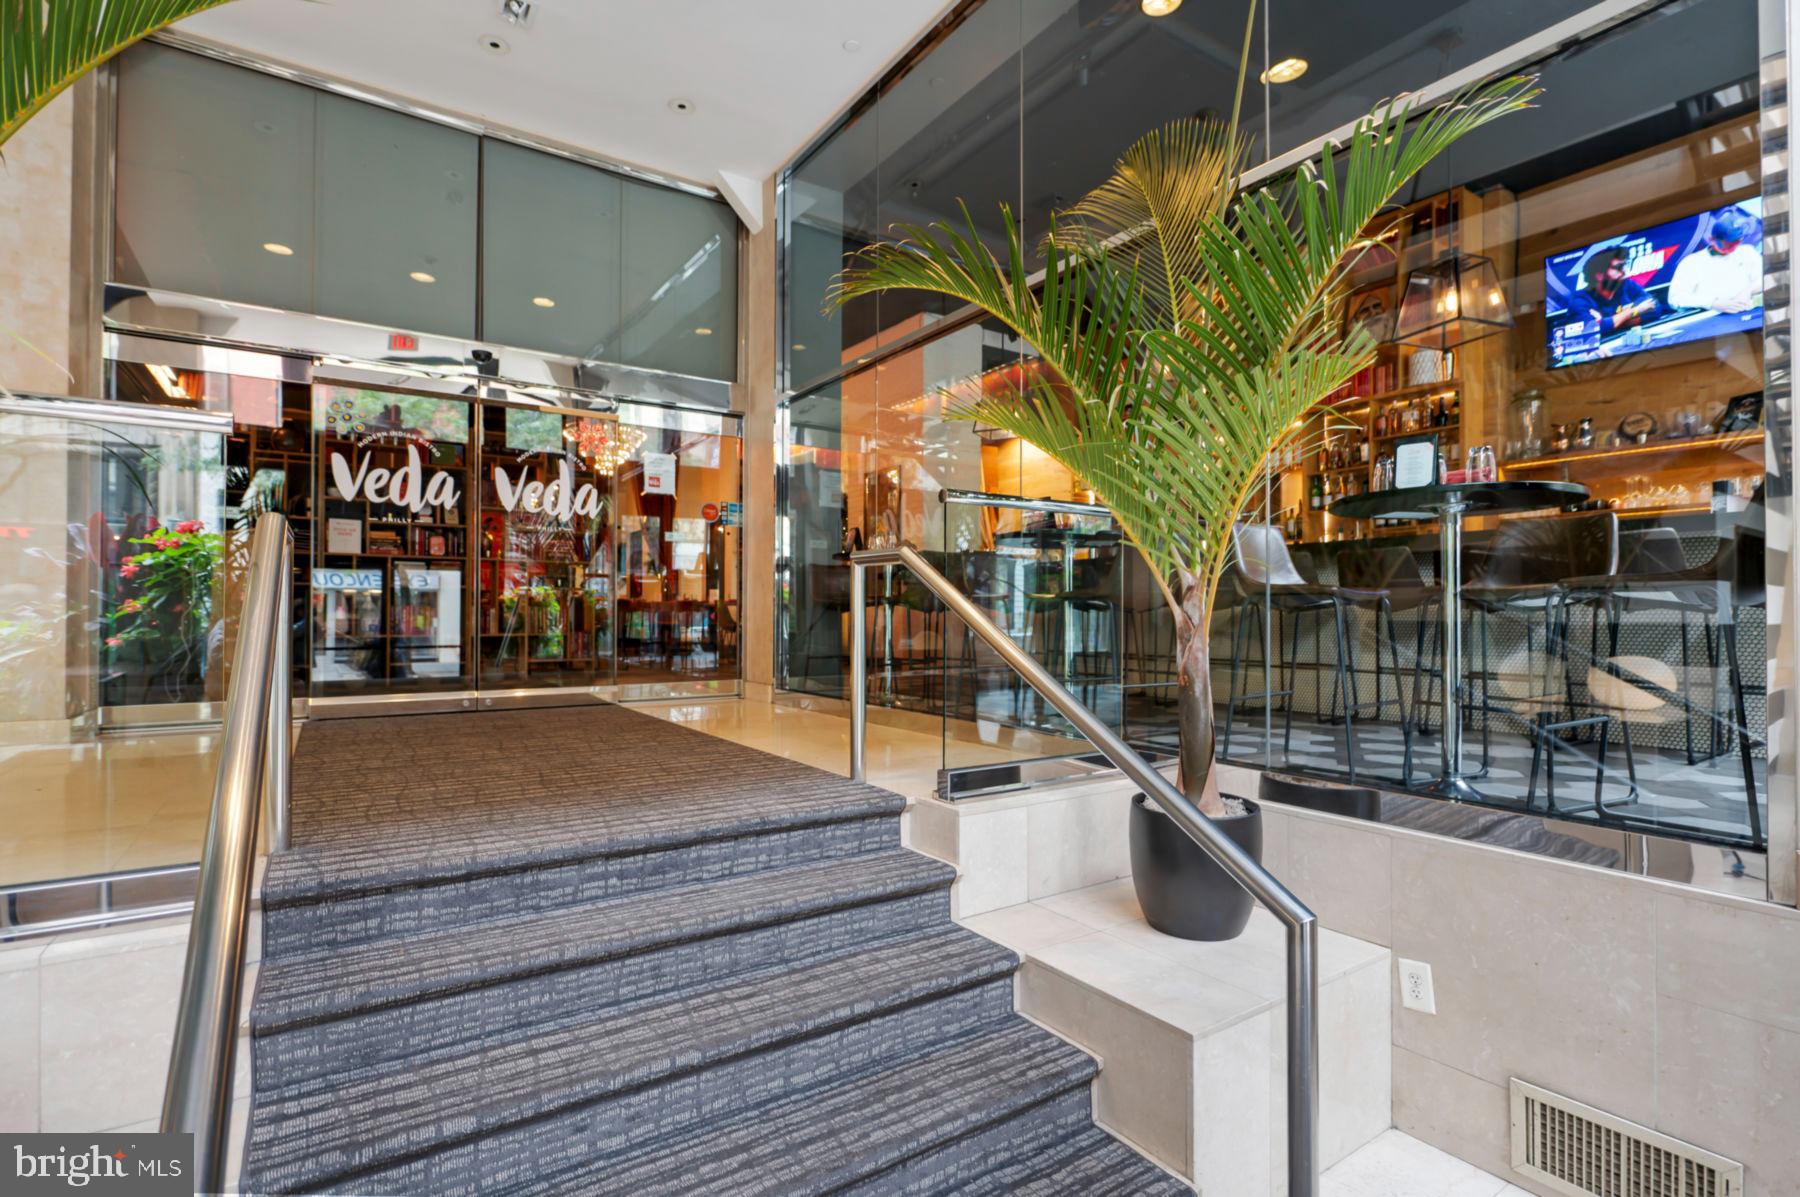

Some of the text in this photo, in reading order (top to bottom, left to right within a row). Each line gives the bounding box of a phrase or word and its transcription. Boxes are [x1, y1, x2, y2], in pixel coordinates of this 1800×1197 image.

[357, 430, 388, 449] MODERN
[389, 430, 417, 440] INDIAN
[331, 443, 461, 513] Veda
[495, 458, 603, 521] Veda
